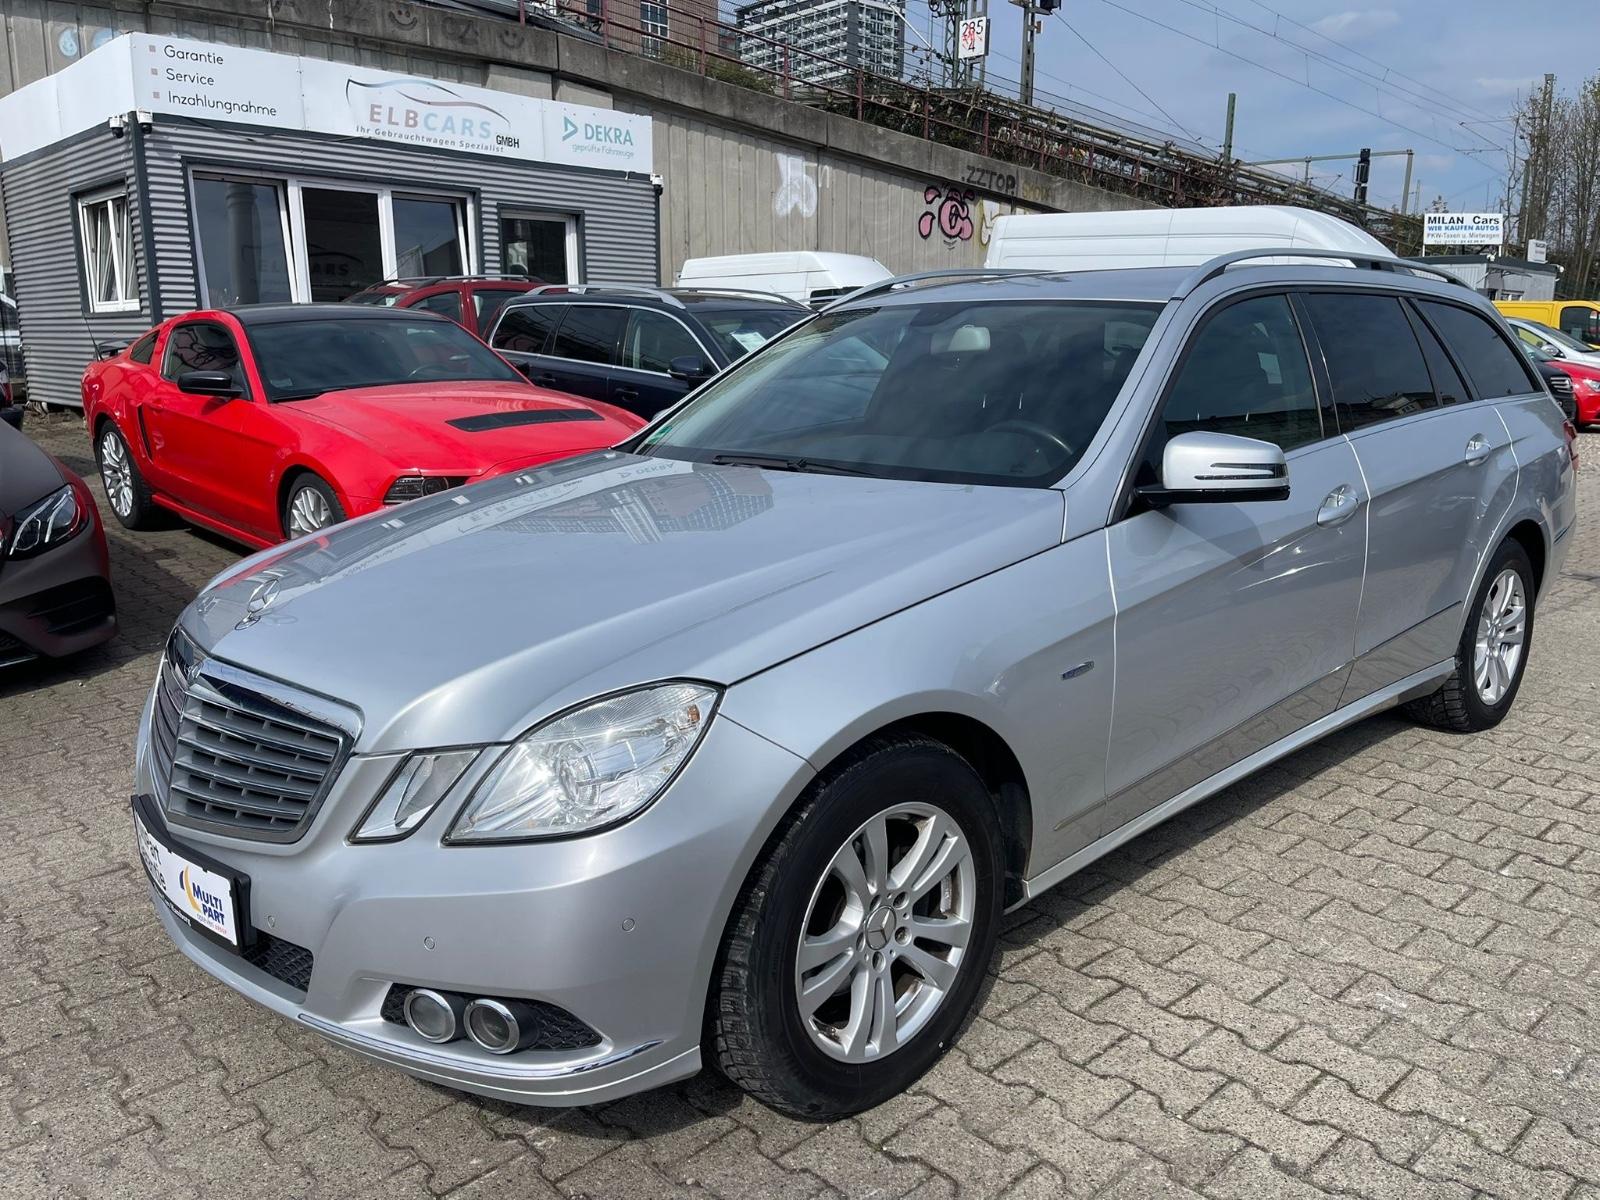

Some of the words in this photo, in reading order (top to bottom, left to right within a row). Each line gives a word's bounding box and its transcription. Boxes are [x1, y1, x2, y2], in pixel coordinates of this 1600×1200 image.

[164, 44, 224, 65] Garantie
[166, 68, 215, 86] Service
[168, 90, 277, 116] Inzahlungnahme
[369, 103, 492, 139] ELBCARS
[356, 125, 370, 134] Ihr
[374, 128, 456, 147] Gebrauchtwagen
[459, 139, 504, 152] Spezialist
[496, 134, 520, 149] GMBH
[584, 123, 633, 146] DEKRA
[1428, 216, 1464, 225] MILAN
[1472, 215, 1500, 225] Cars
[192, 882, 223, 912] MULTI
[202, 904, 225, 926] PART
